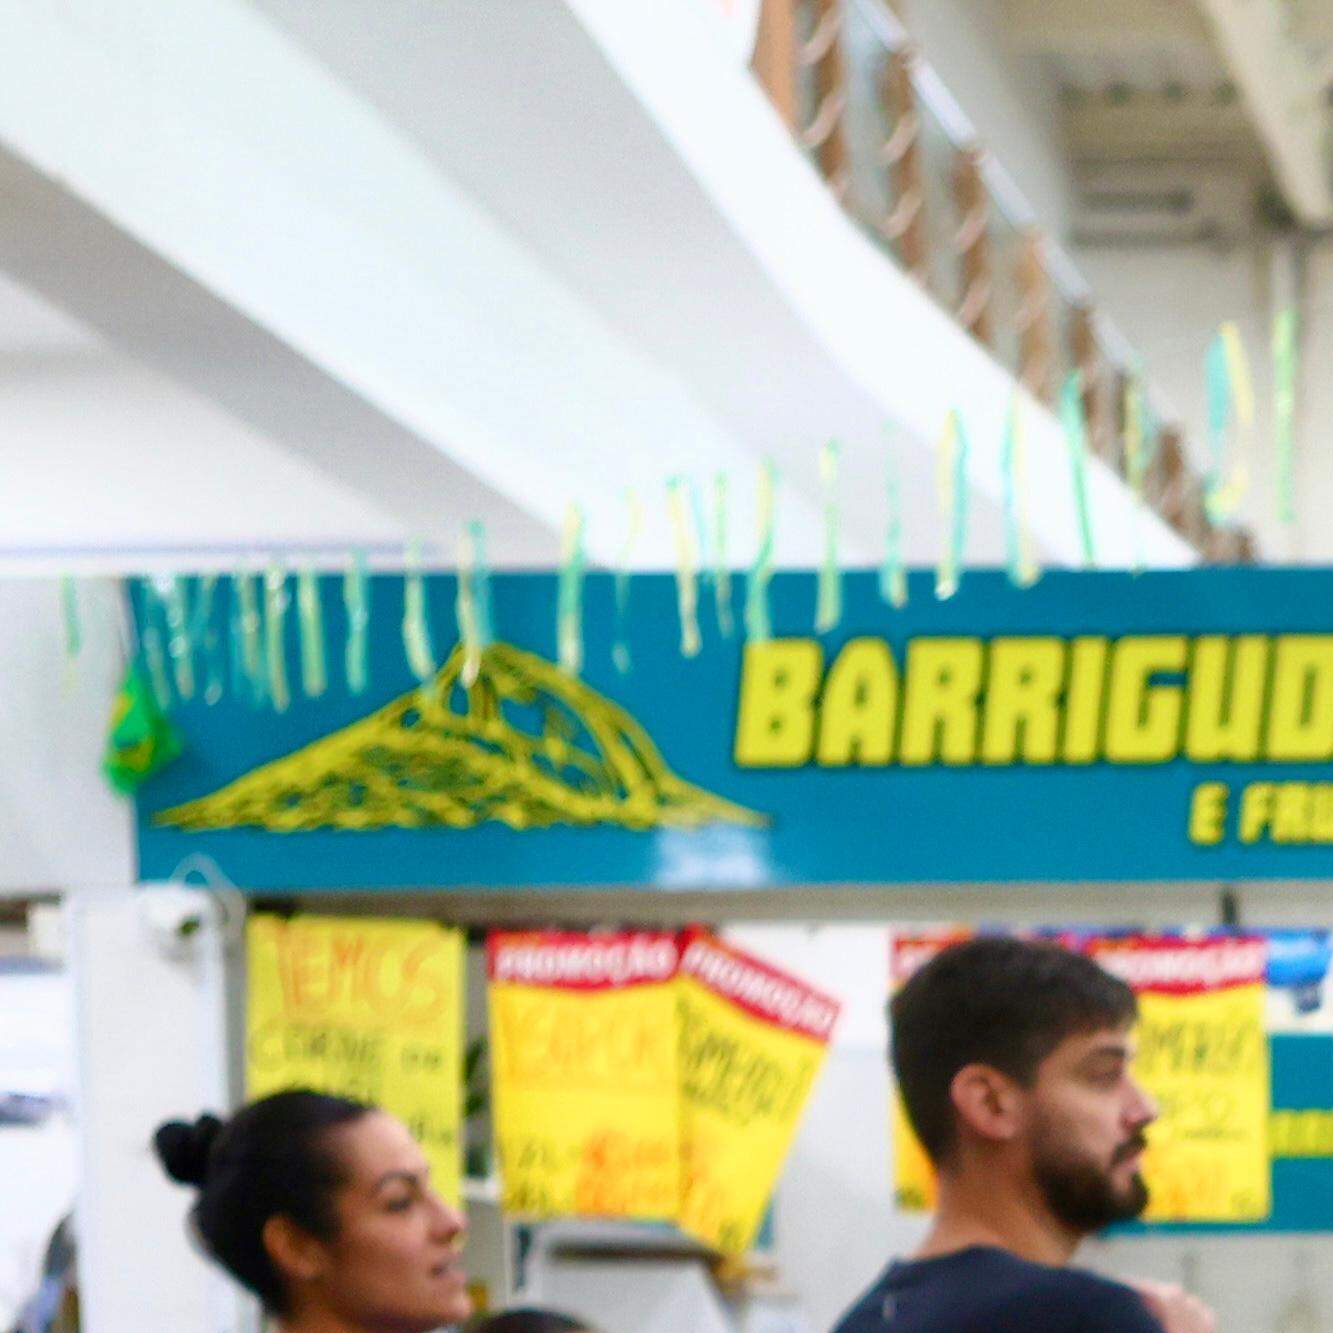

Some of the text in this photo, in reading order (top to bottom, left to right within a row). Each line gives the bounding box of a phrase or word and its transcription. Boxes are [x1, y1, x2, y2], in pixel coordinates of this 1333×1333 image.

[1188, 783, 1228, 844] E
[496, 938, 678, 982] PROMOÇÃO
[684, 938, 832, 1030] PROMOÇÃO
